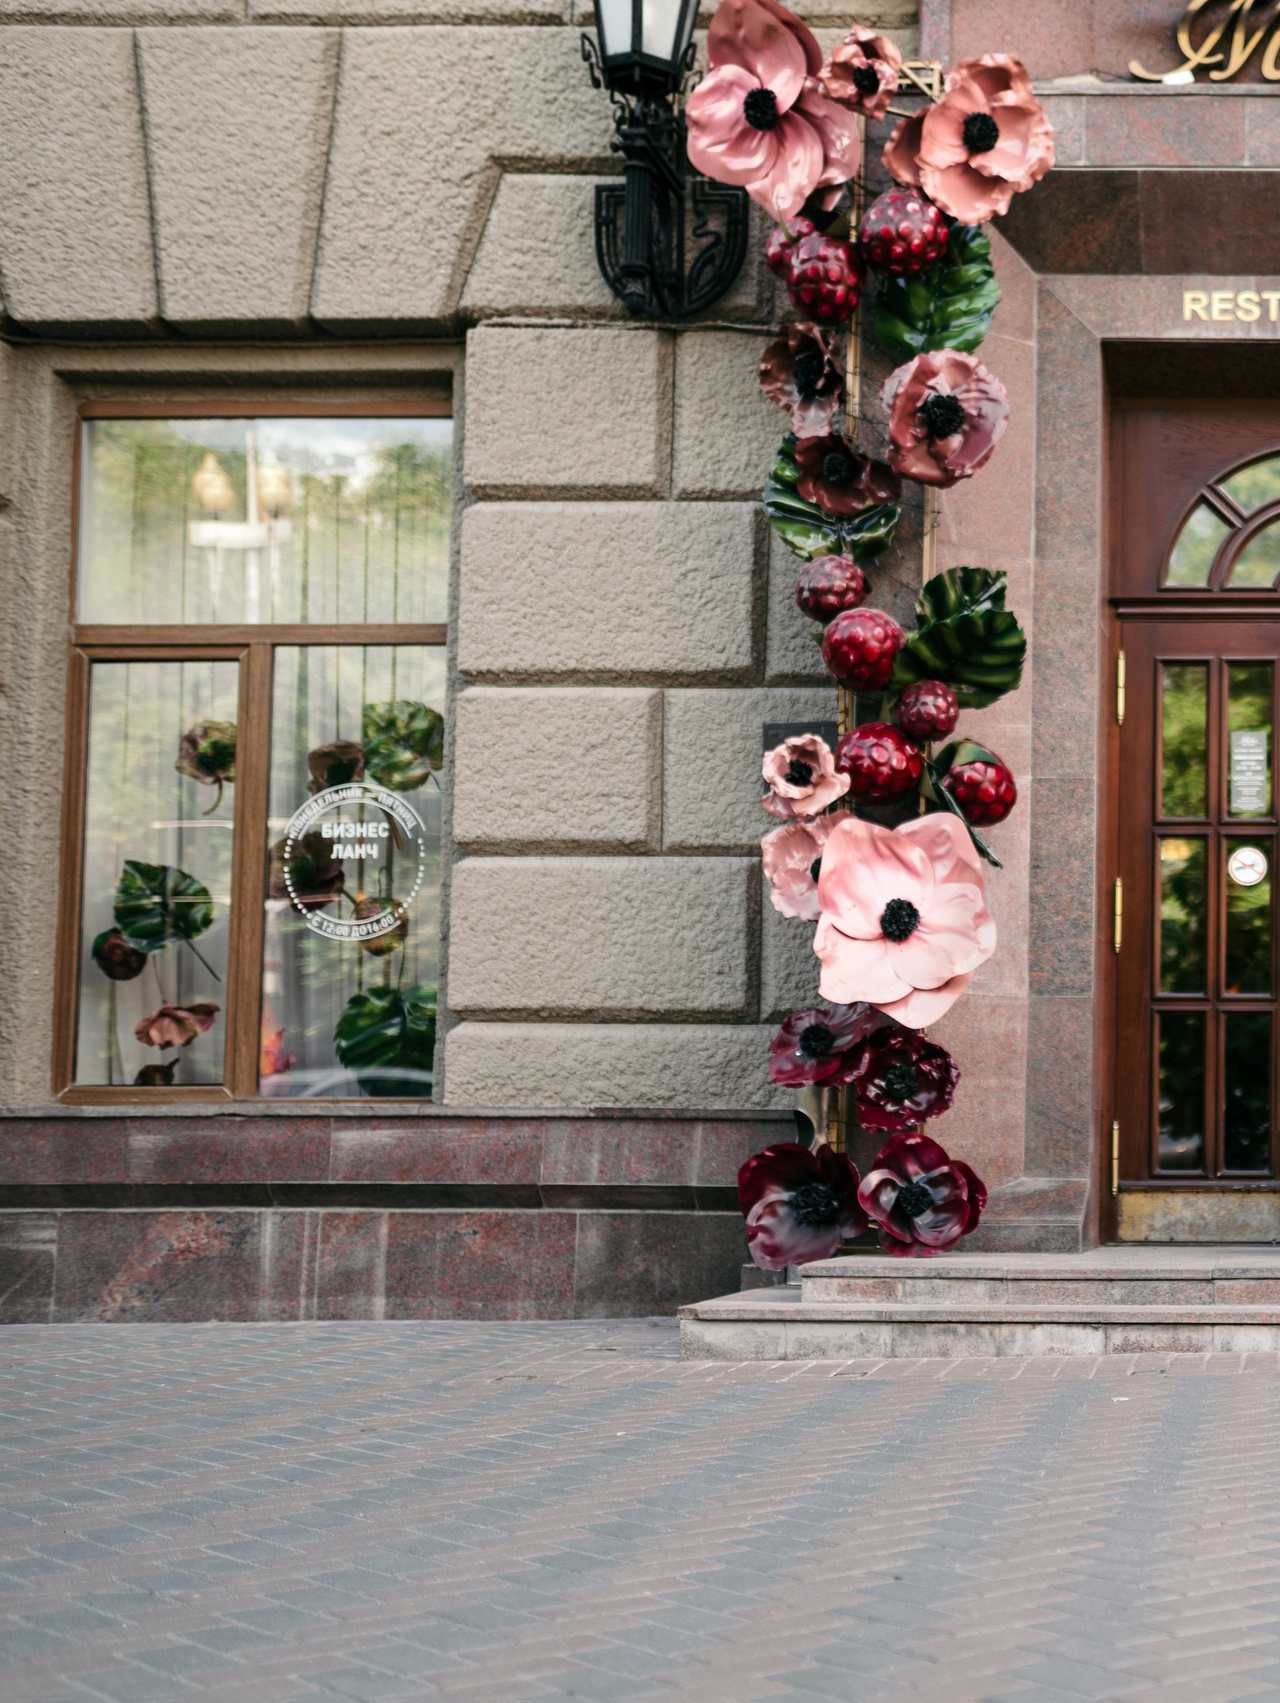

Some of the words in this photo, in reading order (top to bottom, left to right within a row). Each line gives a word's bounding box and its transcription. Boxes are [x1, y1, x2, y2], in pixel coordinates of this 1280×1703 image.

[321, 822, 390, 838] БИЗНЕС
[330, 843, 378, 859] ЛАНЧ
[322, 921, 350, 936] 12:00
